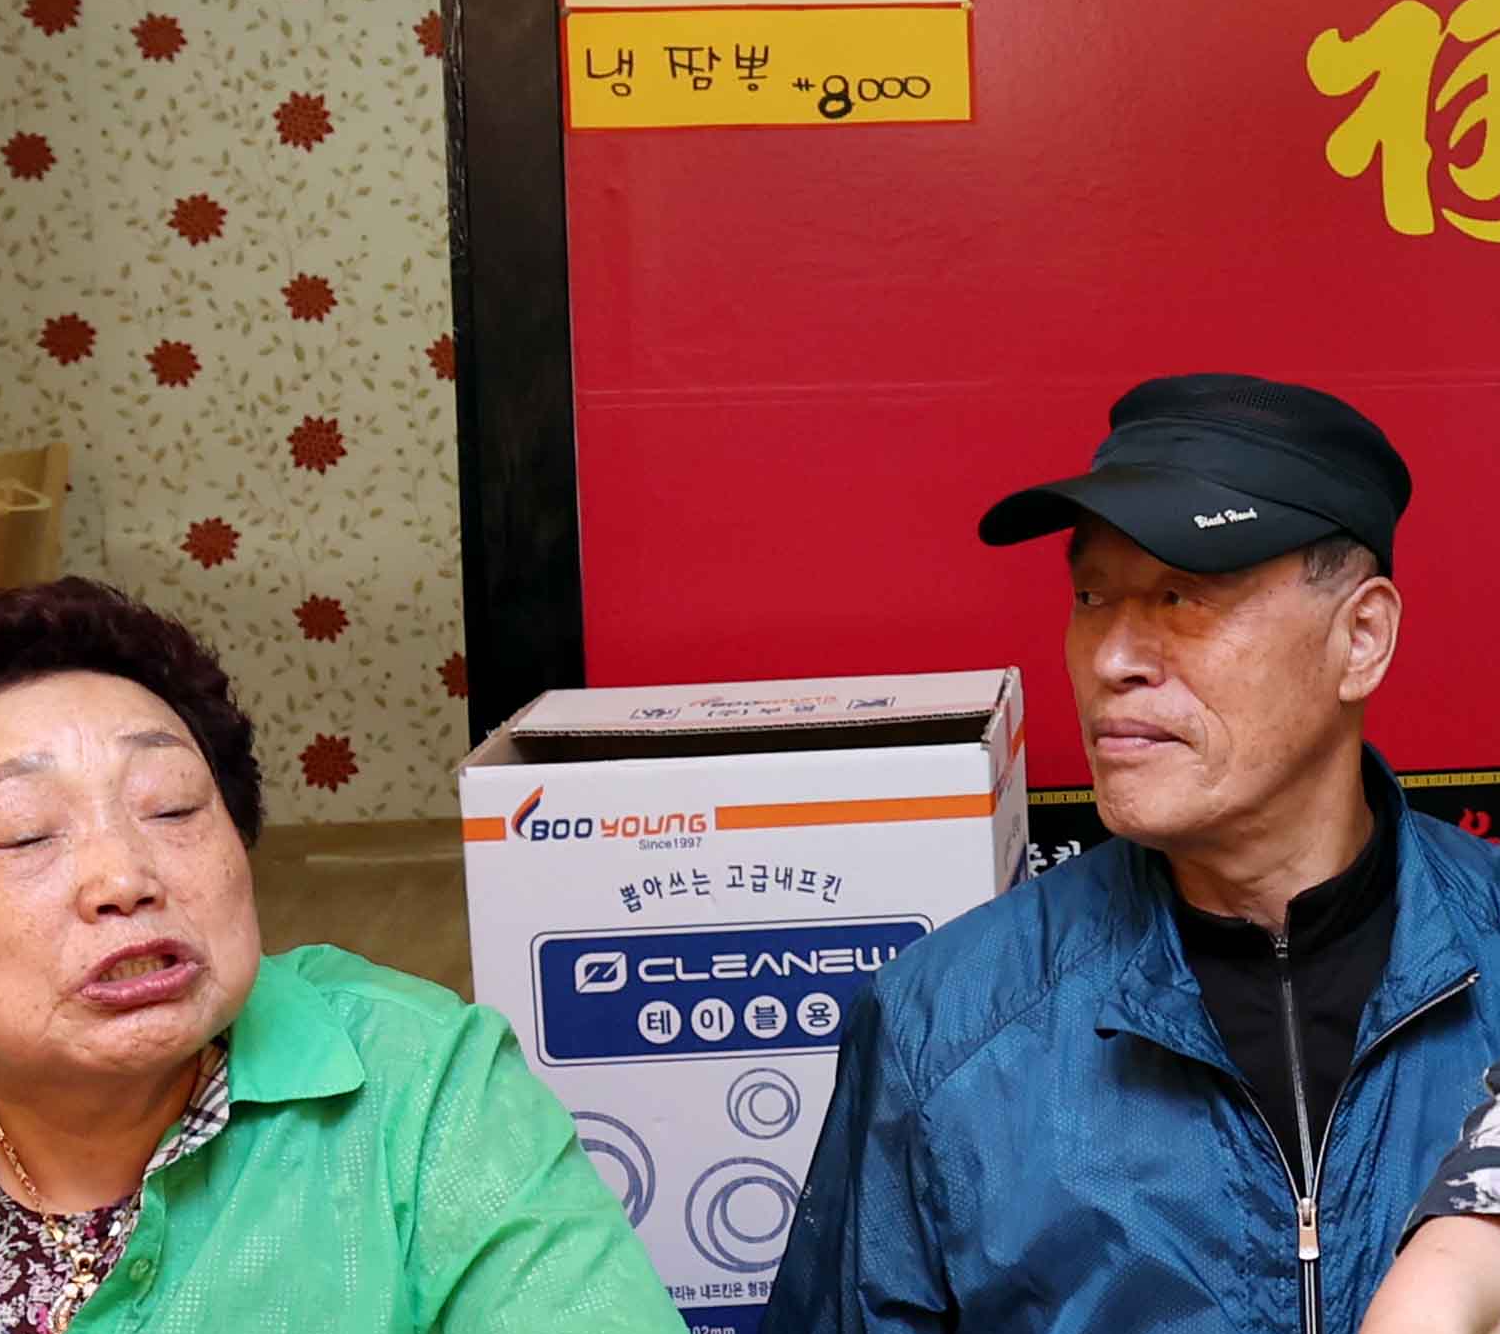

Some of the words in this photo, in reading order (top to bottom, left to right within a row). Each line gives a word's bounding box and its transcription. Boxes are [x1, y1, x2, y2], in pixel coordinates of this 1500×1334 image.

[530, 817, 594, 842] BOO
[600, 812, 708, 838] YOUNG
[619, 867, 712, 914] 뽑아쓰는
[725, 864, 843, 904] 고급내프킨
